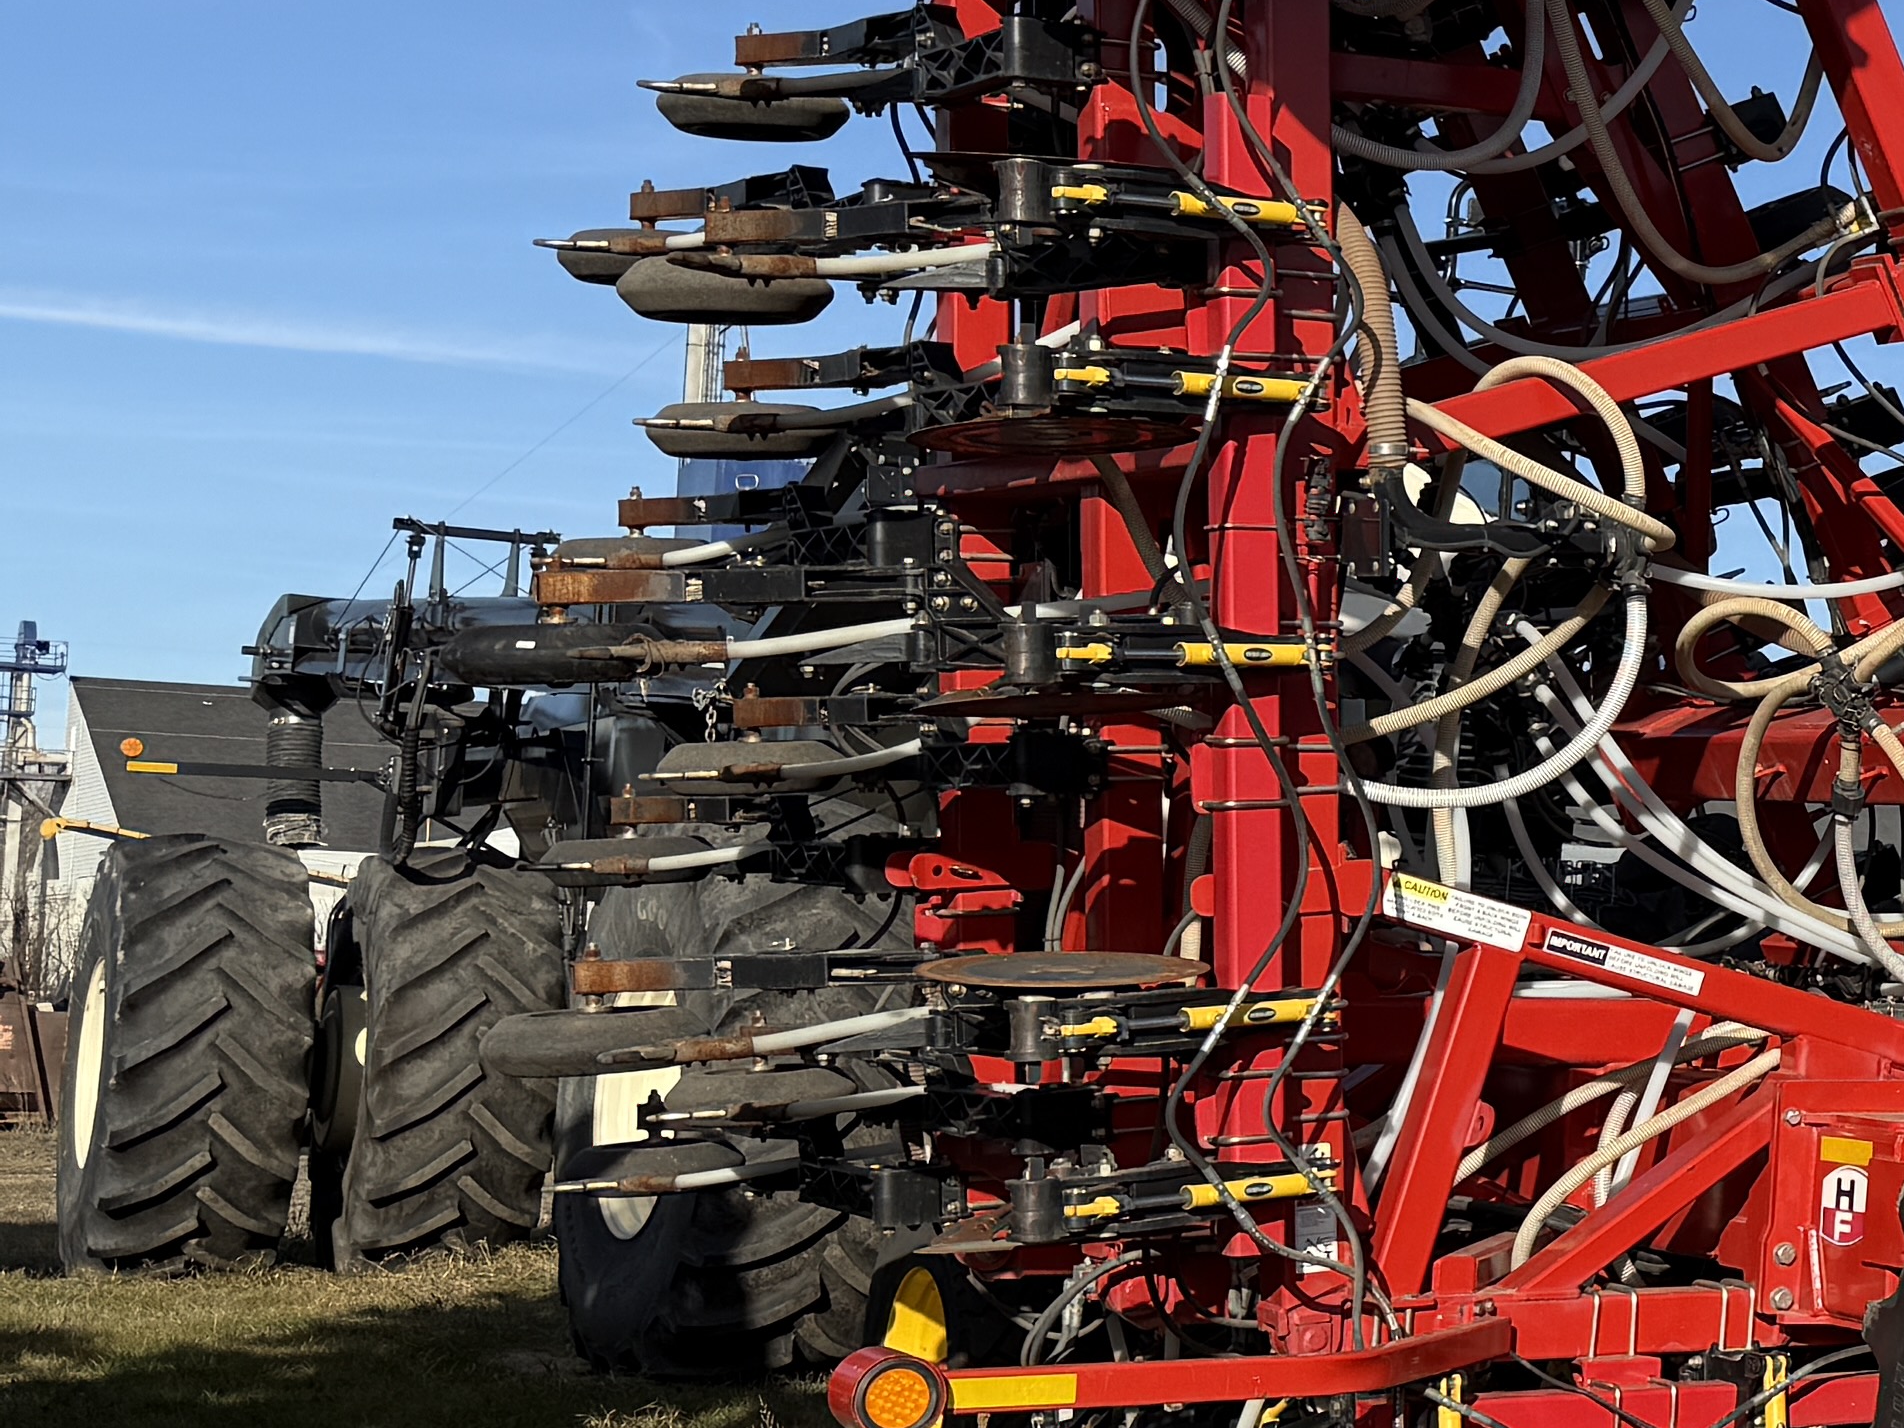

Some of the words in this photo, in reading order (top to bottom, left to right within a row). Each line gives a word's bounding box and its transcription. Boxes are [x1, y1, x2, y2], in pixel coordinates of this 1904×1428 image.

[1404, 880, 1449, 901] CAUTION
[1549, 935, 1607, 961] IMPORTANT
[1835, 1176, 1856, 1211] H
[1832, 1210, 1853, 1242] F
